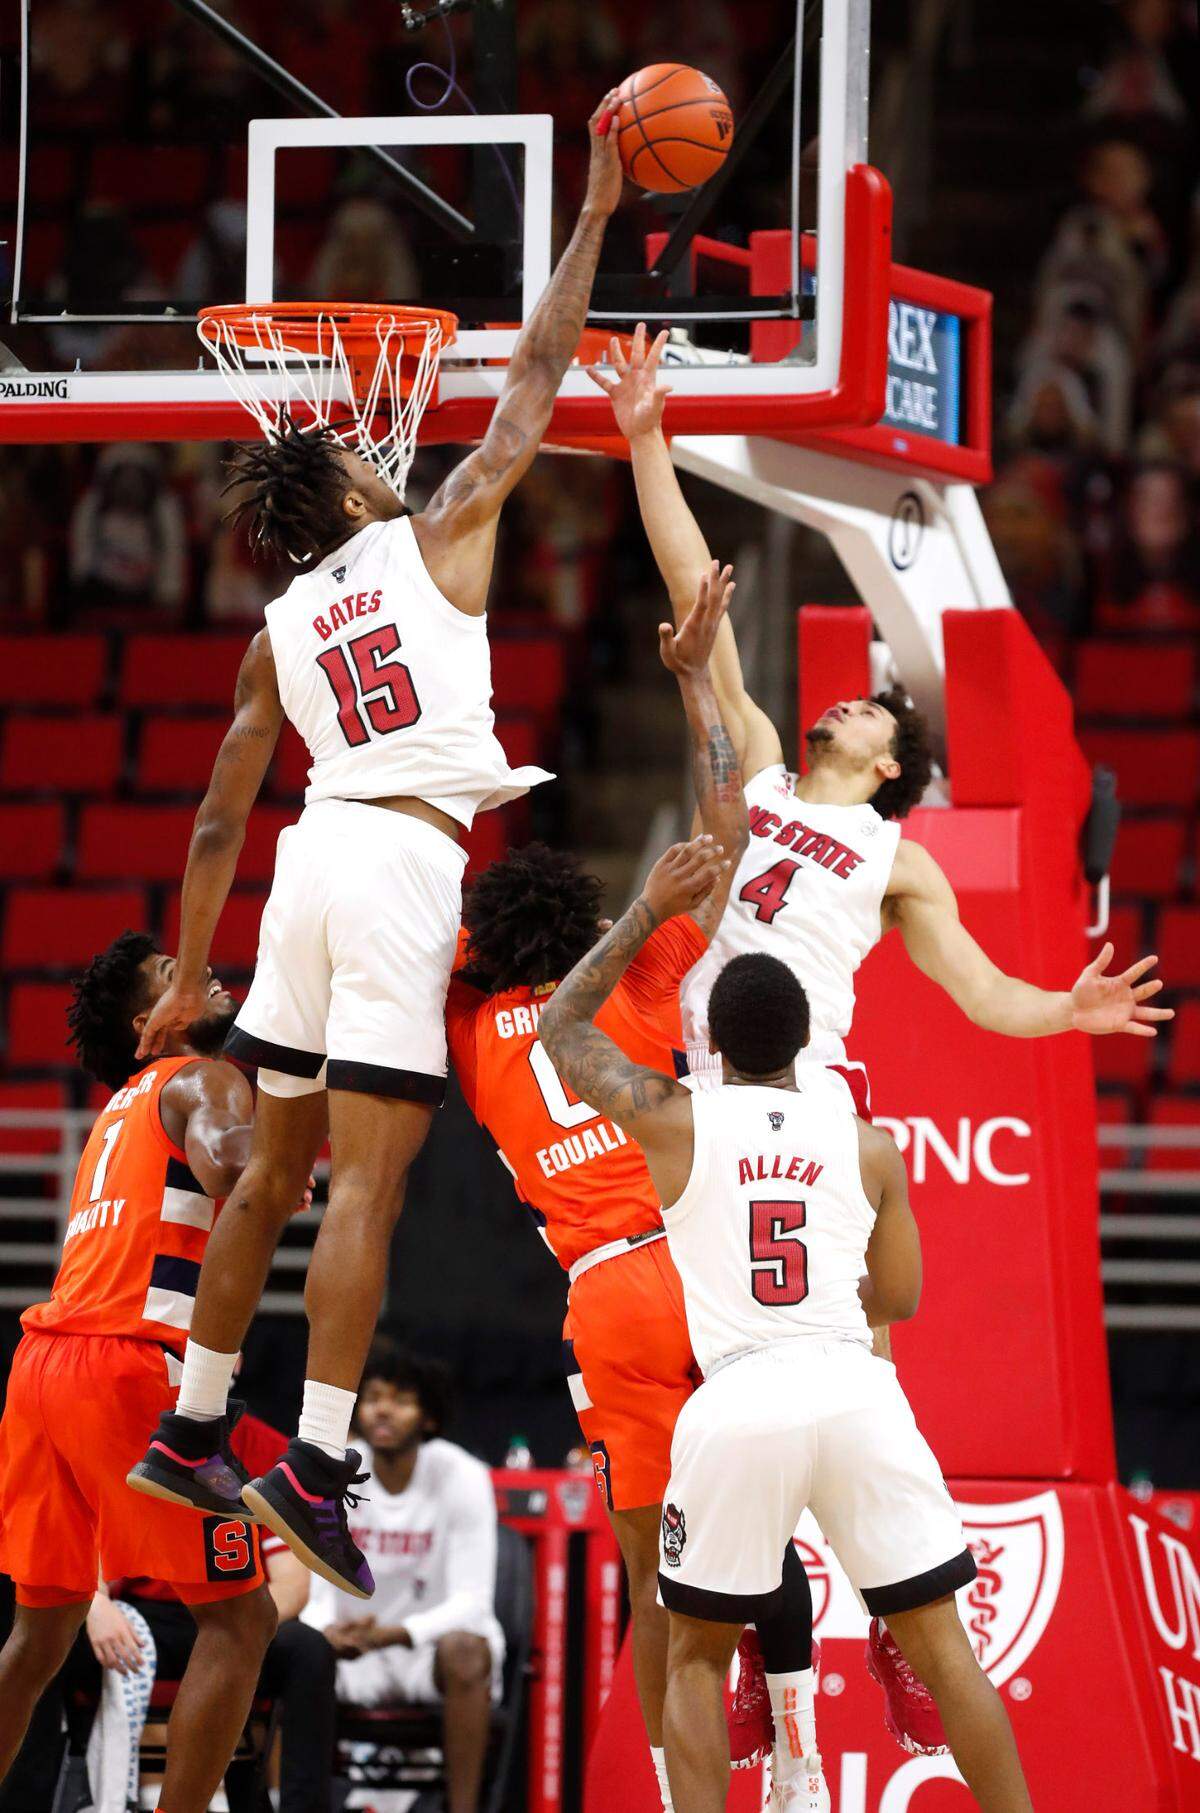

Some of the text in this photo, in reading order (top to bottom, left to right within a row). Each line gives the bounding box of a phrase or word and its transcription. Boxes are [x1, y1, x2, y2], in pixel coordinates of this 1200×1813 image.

[312, 589, 383, 642] BATES
[315, 622, 422, 748] 15
[773, 820, 867, 880] STATE
[739, 858, 804, 925] 4
[88, 1118, 126, 1203] 1
[535, 1120, 638, 1179] EQUALI
[738, 1154, 824, 1187] ALLEN
[749, 1200, 809, 1306] 5
[213, 1520, 250, 1571] S
